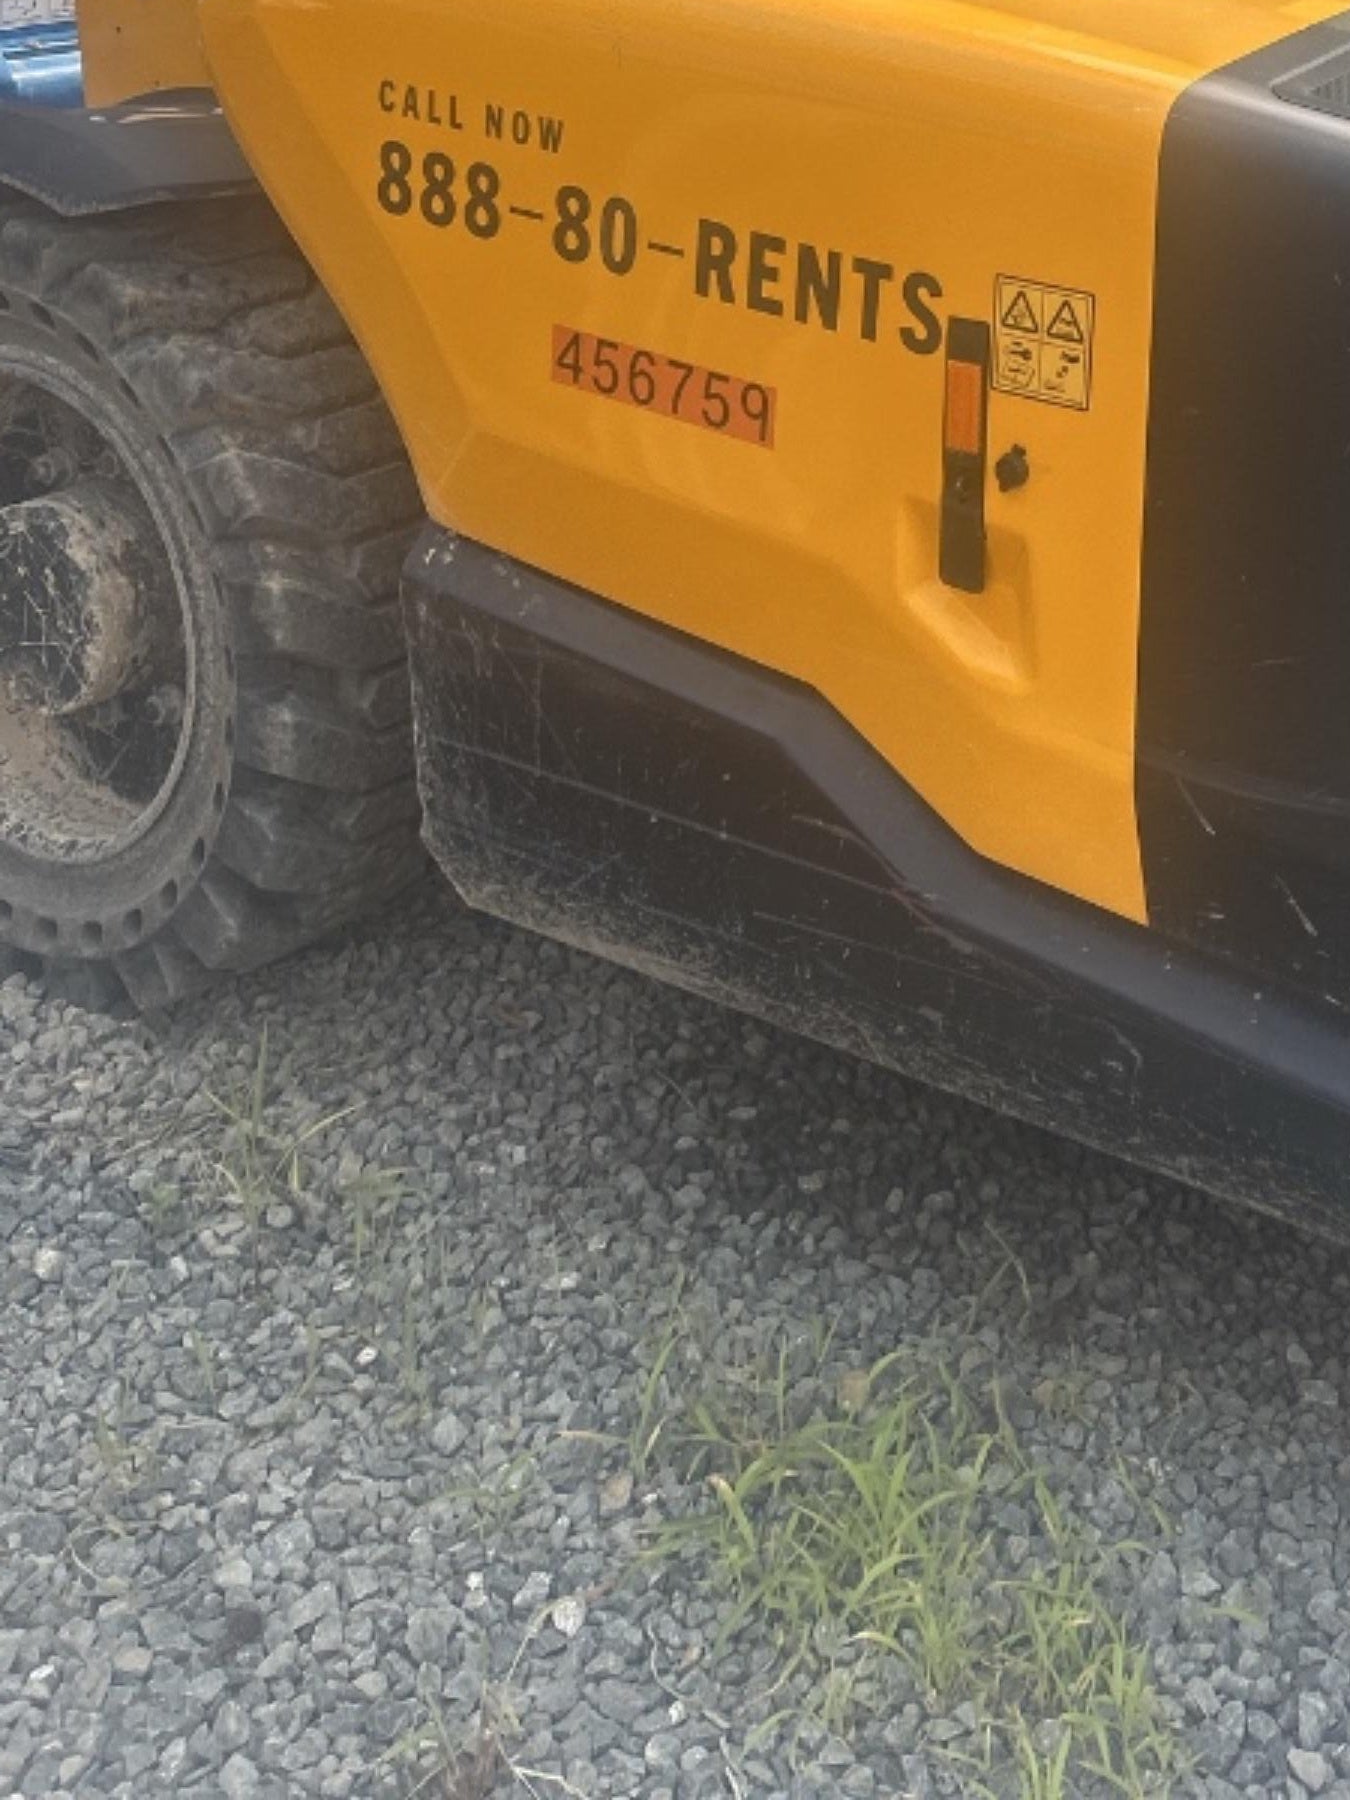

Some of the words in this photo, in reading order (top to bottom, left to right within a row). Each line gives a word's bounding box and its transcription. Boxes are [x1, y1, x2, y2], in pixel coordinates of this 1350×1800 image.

[379, 79, 464, 130] CALL
[484, 104, 565, 154] NOW
[376, 140, 944, 356] 888-80-RENTS
[556, 332, 770, 443] 456759
